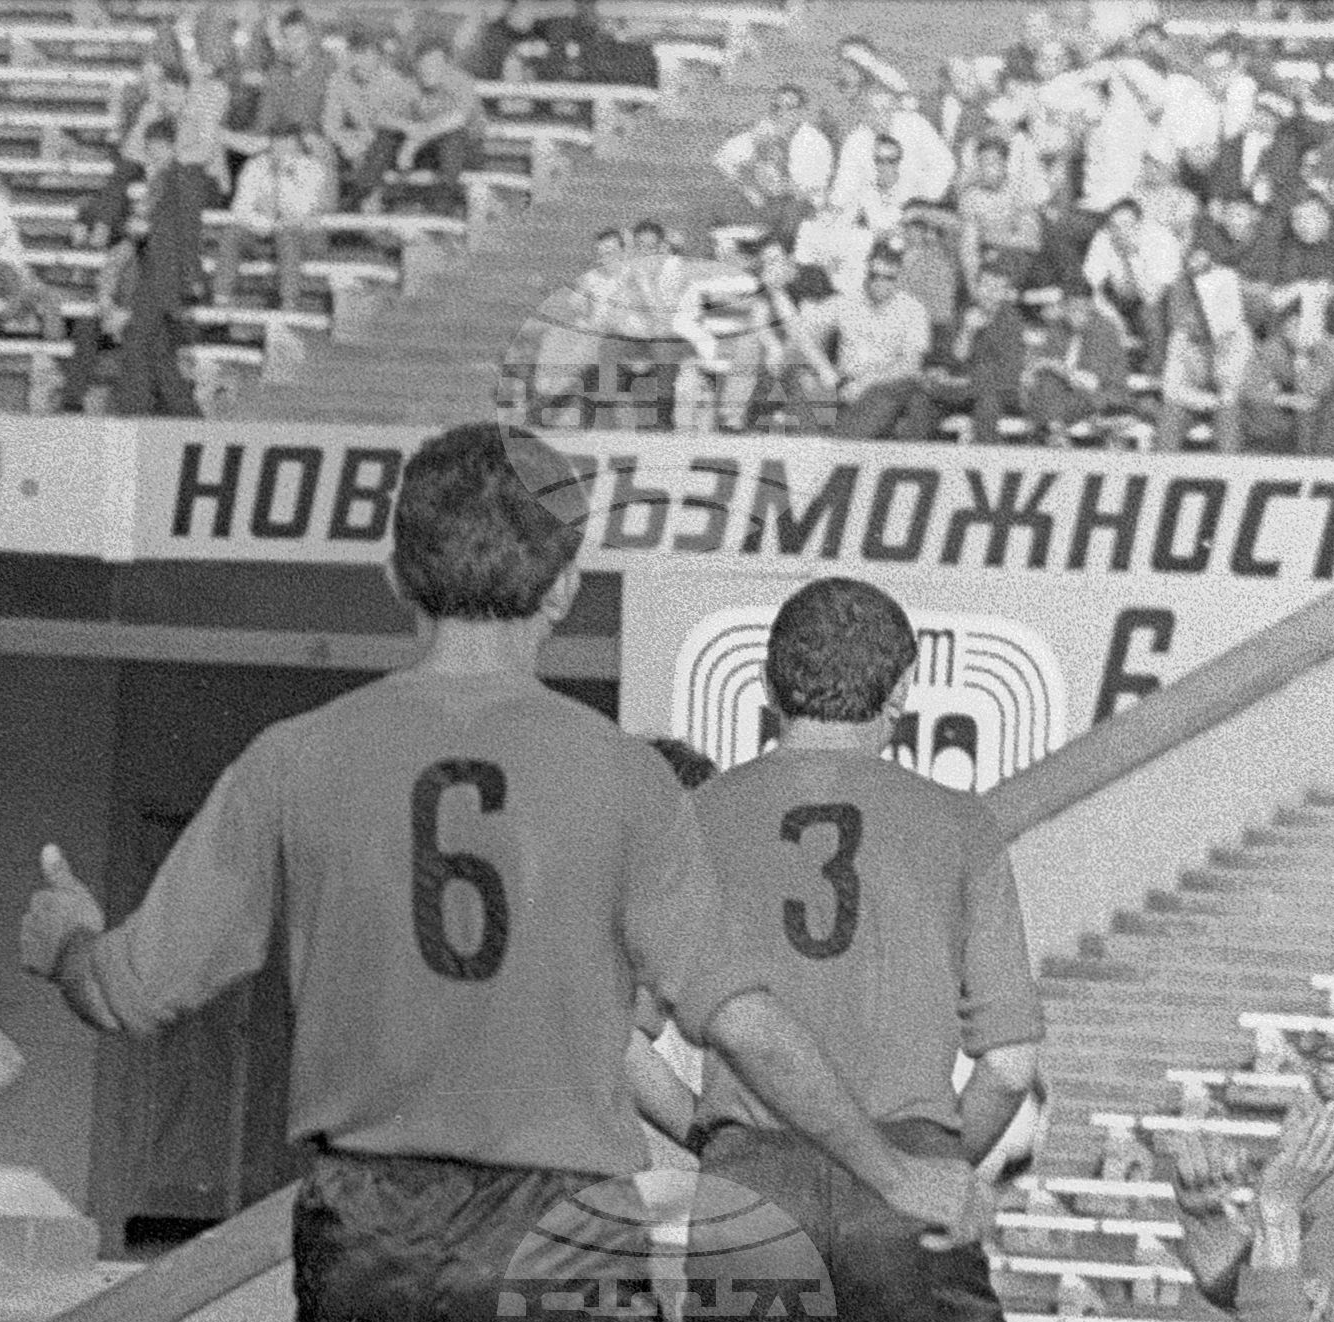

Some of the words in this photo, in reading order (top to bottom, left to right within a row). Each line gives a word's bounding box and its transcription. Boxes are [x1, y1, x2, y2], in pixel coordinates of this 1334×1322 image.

[171, 443, 405, 543] НОВ
[410, 757, 508, 981] 6
[778, 803, 863, 960] 3
